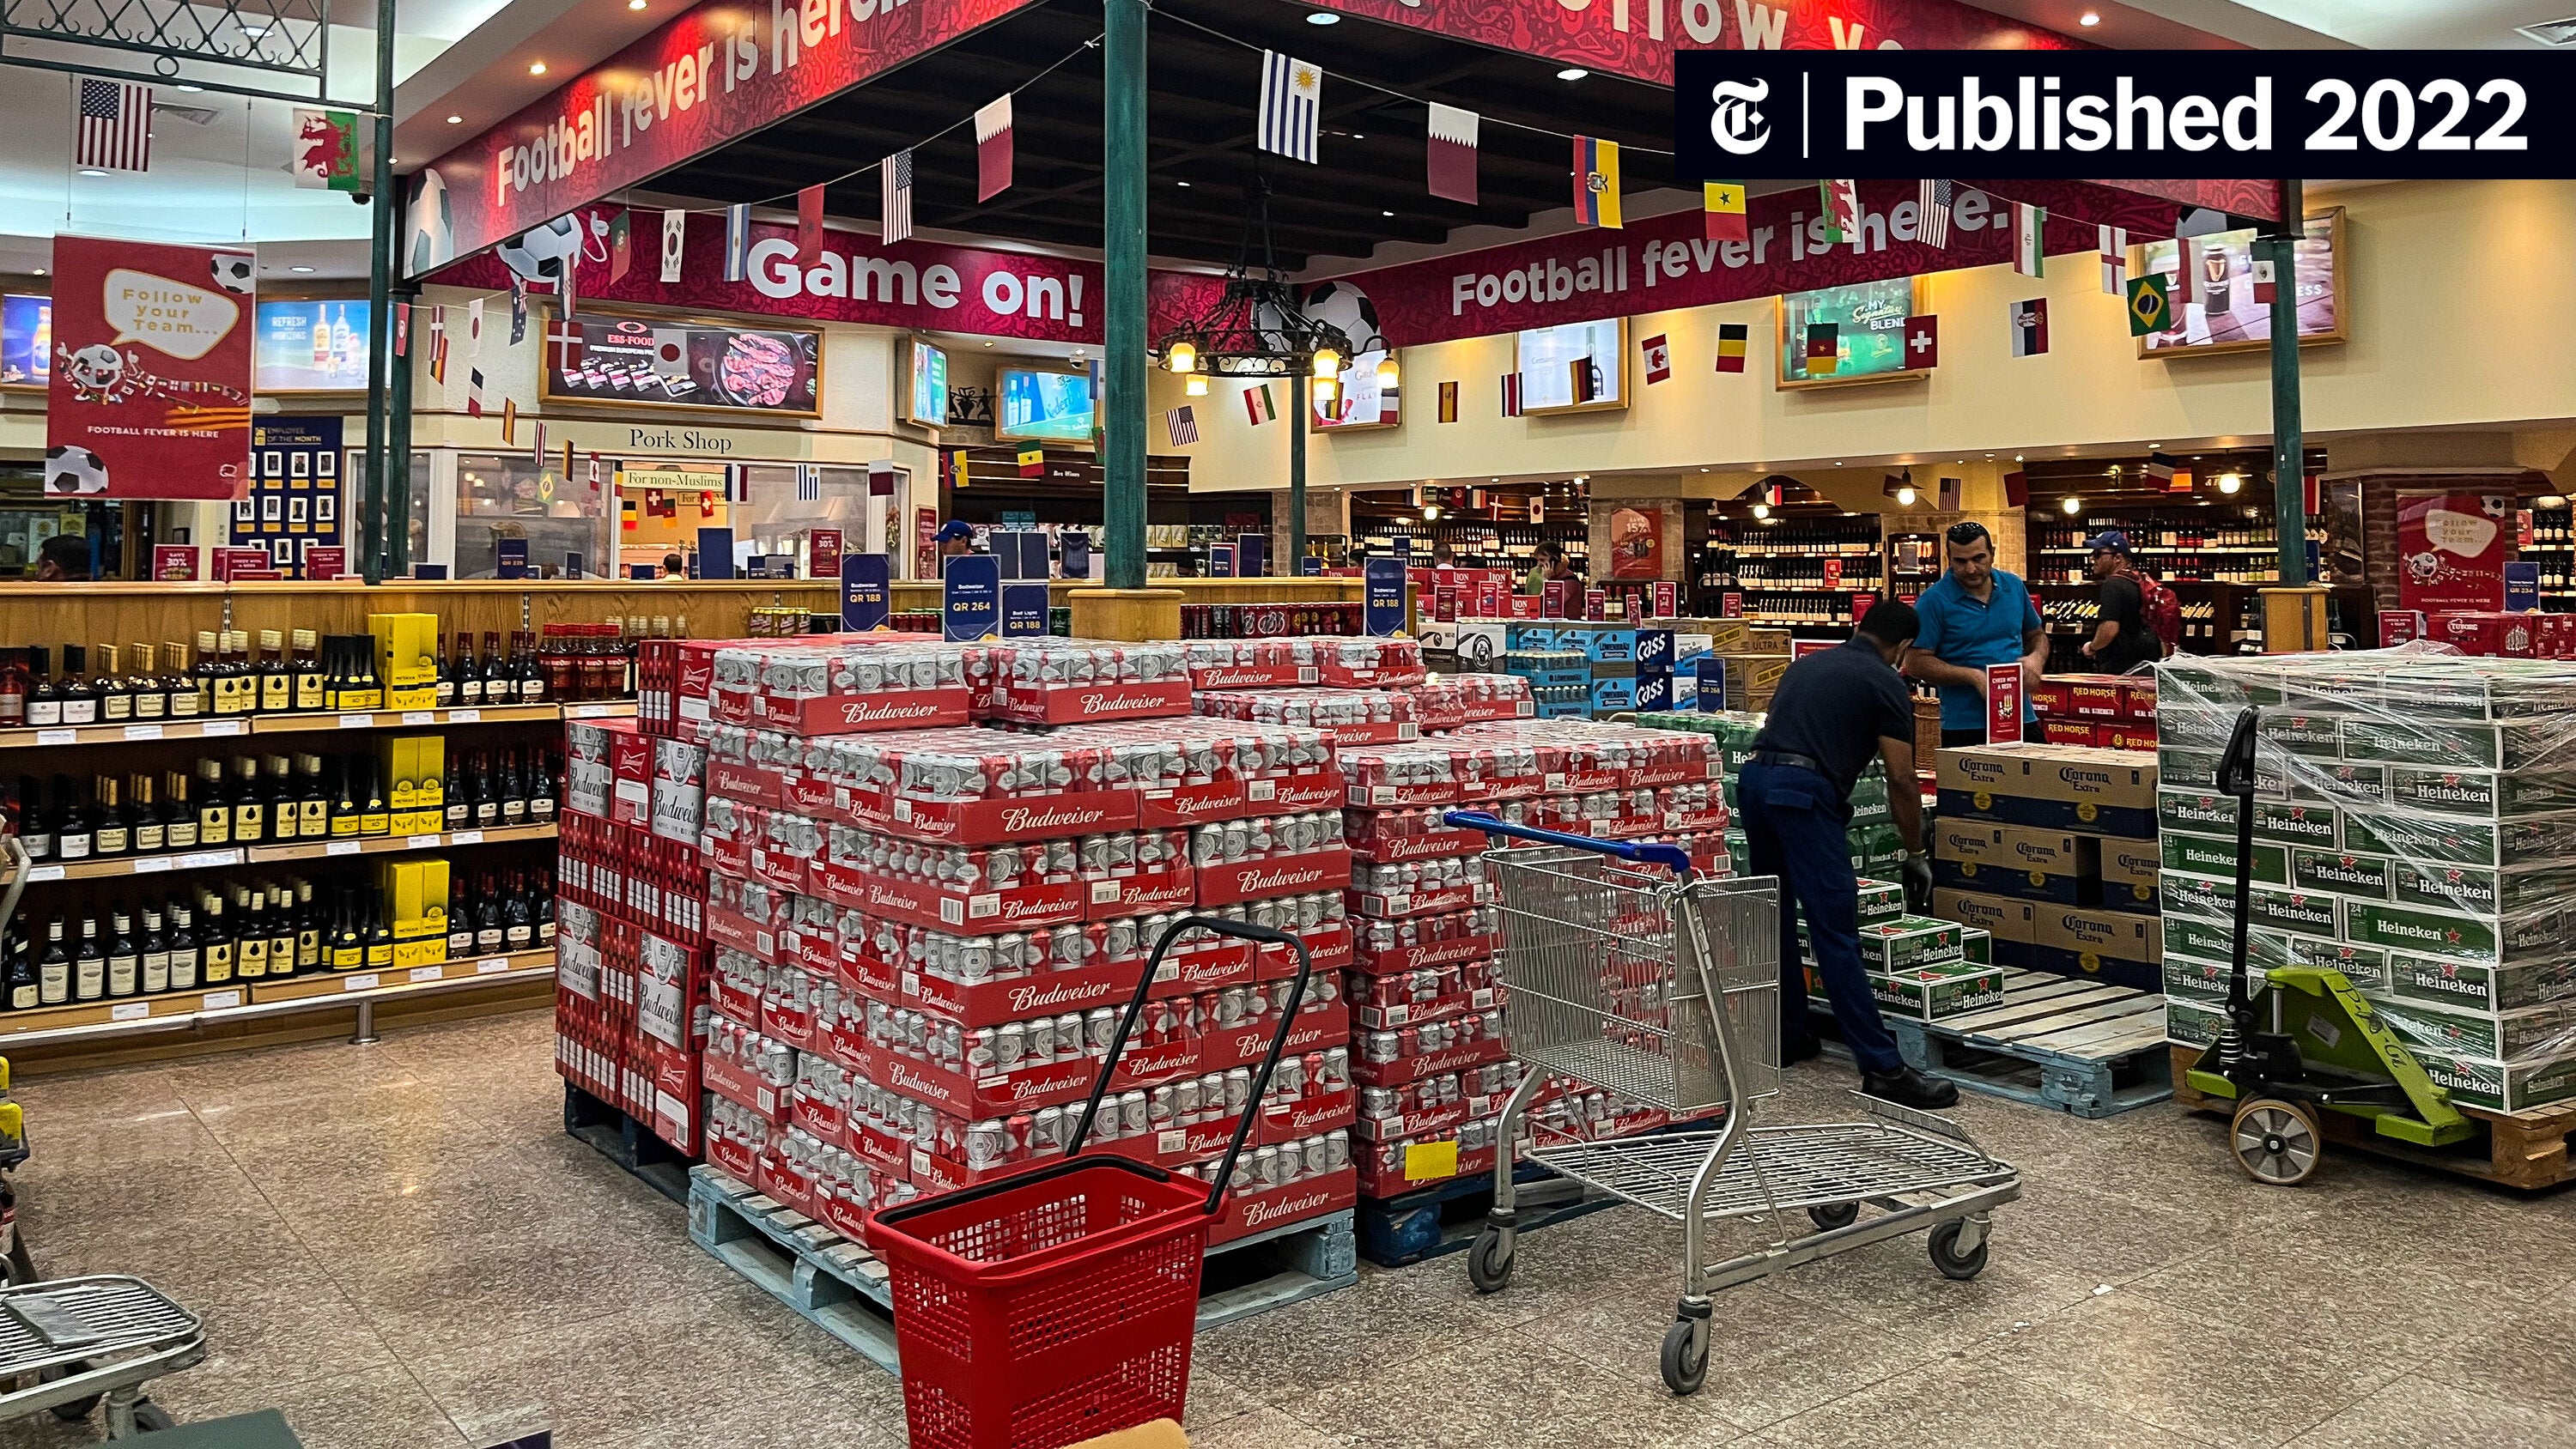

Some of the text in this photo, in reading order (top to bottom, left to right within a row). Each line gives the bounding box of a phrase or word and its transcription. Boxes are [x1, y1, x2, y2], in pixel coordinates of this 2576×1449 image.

[498, 20, 759, 208] Football fever is
[1452, 187, 2011, 319] Football fever is hee.
[747, 238, 1084, 328] Game on!
[123, 288, 203, 304] Follow
[1868, 300, 1886, 310] MY
[137, 305, 189, 318] your
[133, 318, 218, 335] Team...
[271, 316, 307, 327] REFRESH
[87, 426, 140, 436] FOOTBALL
[143, 427, 176, 437] FEVER
[192, 430, 219, 439] HERE
[629, 428, 732, 455] Pork Shop
[628, 472, 723, 488] For non-Muslims
[2441, 519, 2478, 529] ollow
[818, 540, 835, 549] 30%
[166, 558, 187, 567] 30%
[1453, 570, 1469, 582] LION
[1488, 571, 1506, 583] LION
[849, 593, 882, 603] QR 188
[952, 602, 991, 612] QR 264
[1372, 598, 1399, 609] QR 188
[1511, 597, 1528, 611] LION
[1009, 621, 1041, 630] QR 188
[1753, 640, 1779, 652] ULTRA
[1203, 670, 1273, 686] Budweiser
[2032, 694, 2057, 704] HORSE
[2073, 686, 2116, 699] RED HORSE
[841, 701, 939, 724] Budweiser
[1007, 695, 1045, 714] Budweiser
[1080, 693, 1165, 716] Budweiser
[1419, 711, 1462, 728] Budweiser
[2048, 724, 2090, 735] RED HORSE
[2268, 728, 2335, 745] Heineken
[2126, 737, 2142, 748] RED
[1959, 756, 2005, 775] Corona
[719, 770, 762, 795] Budweiser
[1565, 773, 1616, 789] Budweiser
[1627, 768, 1686, 787] Budweiser
[1971, 774, 1996, 783] Extra
[2059, 766, 2111, 785] Corona
[1277, 787, 1340, 804] Budweiser
[1397, 786, 1455, 804] Budweiser
[2072, 782, 2100, 793] Extra
[2417, 785, 2490, 803] Heineken
[851, 799, 892, 822] Budweiser
[1175, 793, 1242, 815] Budweiser
[912, 811, 957, 834] Budweiser
[1001, 806, 1105, 833] Budweiser
[1611, 819, 1658, 835] Budweiser
[1681, 811, 1728, 828] Budweiser
[2267, 816, 2333, 836] Heineken
[1387, 836, 1461, 858] Budweiser
[1948, 834, 1988, 849] Corona
[2163, 834, 2173, 844] 24
[1959, 846, 1979, 855] Extra
[2015, 840, 2057, 858] Corona
[2026, 855, 2048, 864] Extra
[2117, 853, 2161, 870] Corona
[1236, 866, 1324, 894] Budweiser
[2129, 866, 2153, 877] Extra
[2316, 865, 2385, 887] Heineken
[869, 883, 919, 912] Budweiser
[1121, 885, 1191, 906] Budweiser
[2419, 878, 2493, 900] Heineken
[1001, 898, 1080, 919] Budweiser
[2178, 888, 2236, 910] Heineken
[2350, 903, 2361, 913] 24
[1867, 901, 1903, 917] Heineken
[1957, 899, 2006, 919] Corona
[2268, 903, 2333, 925] Heineken
[1969, 916, 1995, 927] Extra
[2062, 914, 2116, 937] Corona
[2166, 919, 2175, 927] 24
[2377, 919, 2443, 942] Heineken
[2075, 931, 2104, 944] Extra
[1286, 944, 1350, 966] Bdweiser
[1406, 943, 1478, 967] Budweiser
[1181, 957, 1249, 983] Budweiser
[2315, 955, 2382, 979] Heineken
[2415, 973, 2488, 997] Heineken
[920, 986, 965, 1013] Budweiser
[1007, 980, 1111, 1013] Budweiser
[1871, 987, 1923, 1009] Heineken
[833, 1034, 872, 1064] Budweiser
[1128, 1052, 1199, 1077] Budweiser
[1411, 1049, 1481, 1077] Budweiser
[889, 1060, 951, 1101] Budweiser
[1011, 1075, 1088, 1100] Budweiser
[2428, 1068, 2502, 1096] Heineken
[1291, 1101, 1353, 1129] Budweiser
[1405, 1107, 1463, 1132] Budweiser
[1615, 1112, 1664, 1132] Budweiser
[862, 1135, 904, 1167] Budweiser
[1242, 1191, 1330, 1228] Budweiser
